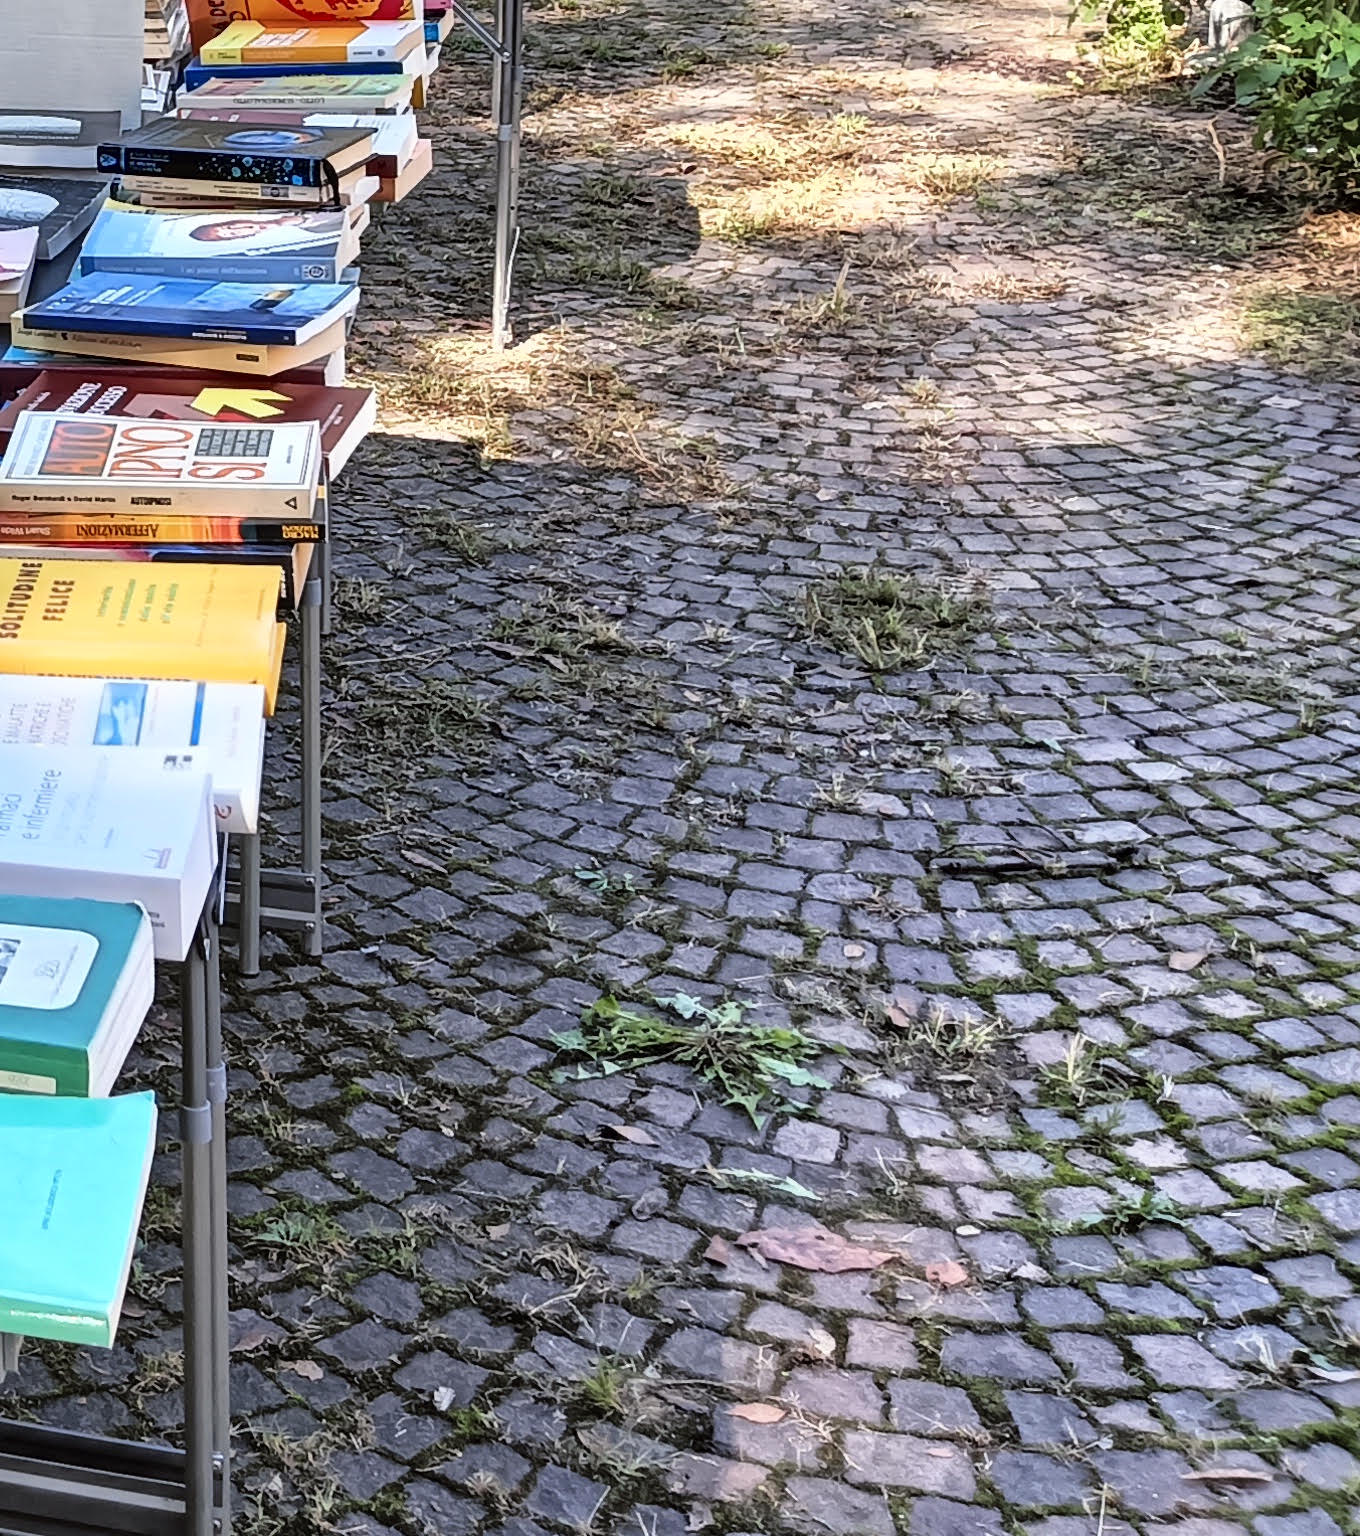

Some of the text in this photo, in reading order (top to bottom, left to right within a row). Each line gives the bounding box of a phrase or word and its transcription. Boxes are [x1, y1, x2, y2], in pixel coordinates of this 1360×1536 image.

[43, 422, 115, 477] AUTO
[107, 425, 196, 478] IPNO
[188, 460, 268, 481] SI
[75, 523, 160, 539] AFFERMAZIONI
[42, 579, 76, 622] FELICE
[30, 768, 62, 830] infermiere
